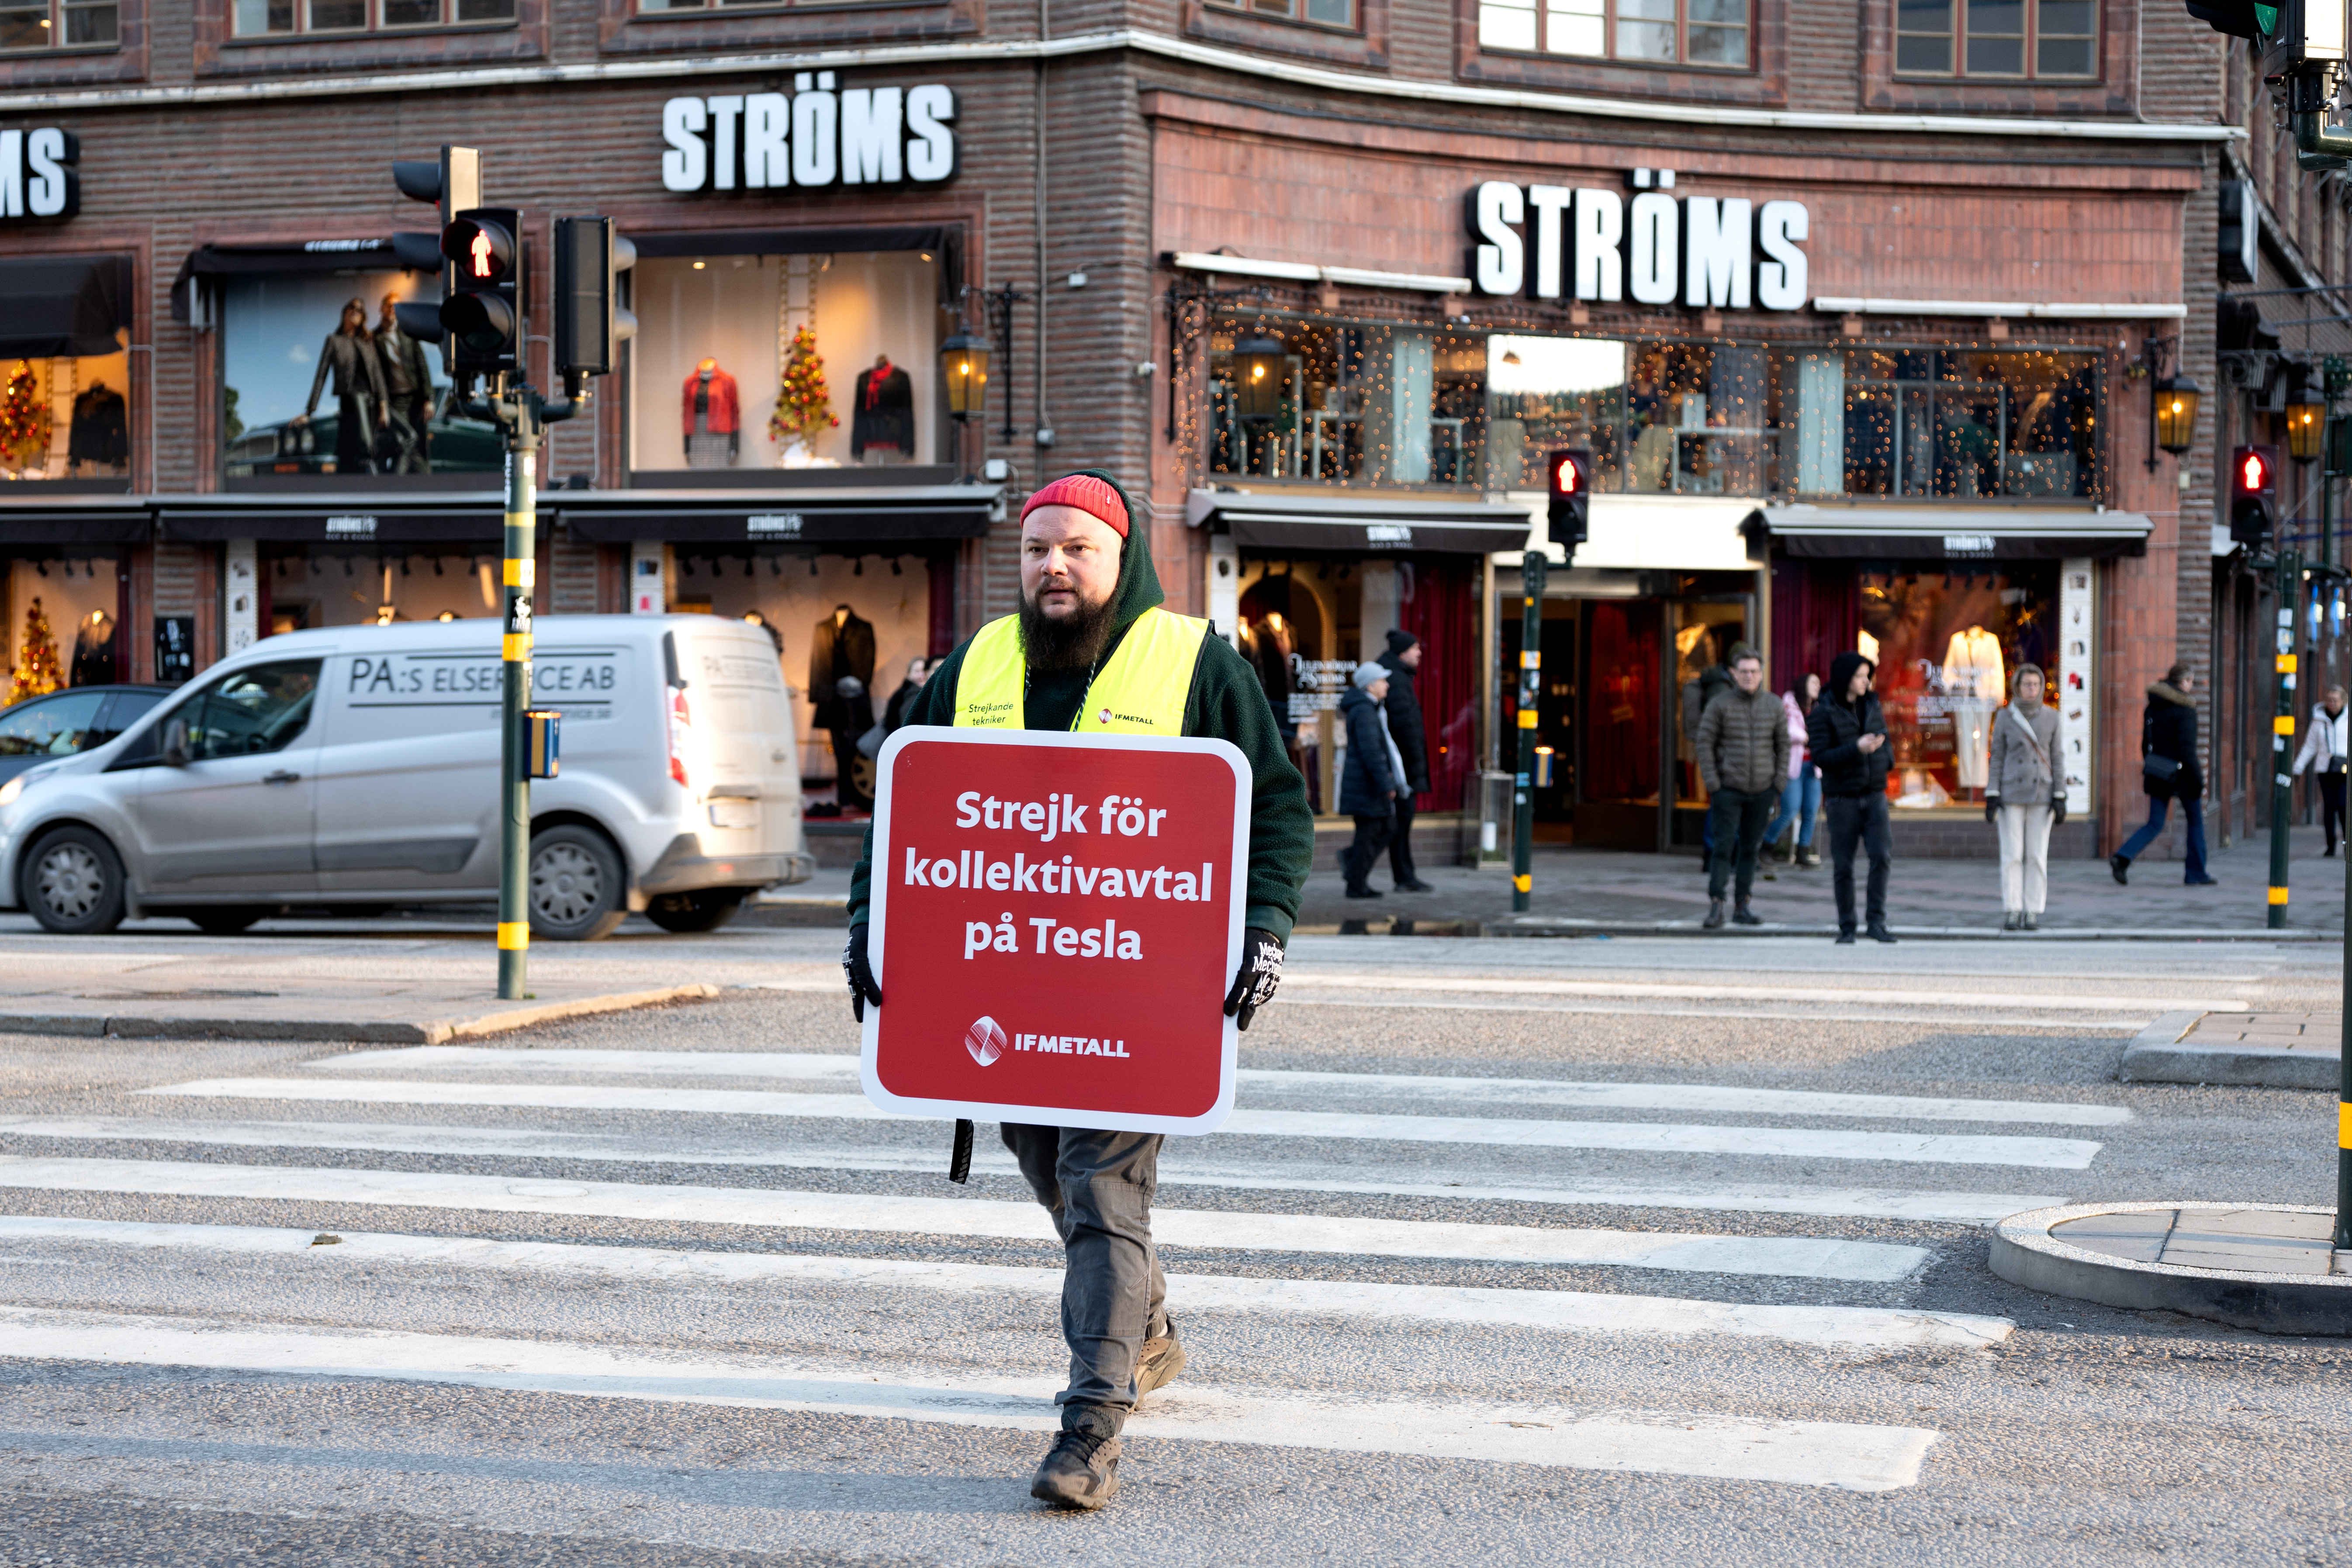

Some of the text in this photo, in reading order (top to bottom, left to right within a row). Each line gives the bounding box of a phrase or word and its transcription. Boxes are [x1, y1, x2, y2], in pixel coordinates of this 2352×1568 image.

[662, 70, 954, 192] STRÖMS
[1477, 167, 1809, 311] STRÖMS
[579, 665, 616, 691] AB
[968, 701, 1013, 714] Strejkande
[972, 715, 1006, 725] tekniker
[955, 791, 1167, 842] Strejk för
[904, 846, 1213, 902] kollektivavtal
[964, 912, 1143, 960] på Tesla
